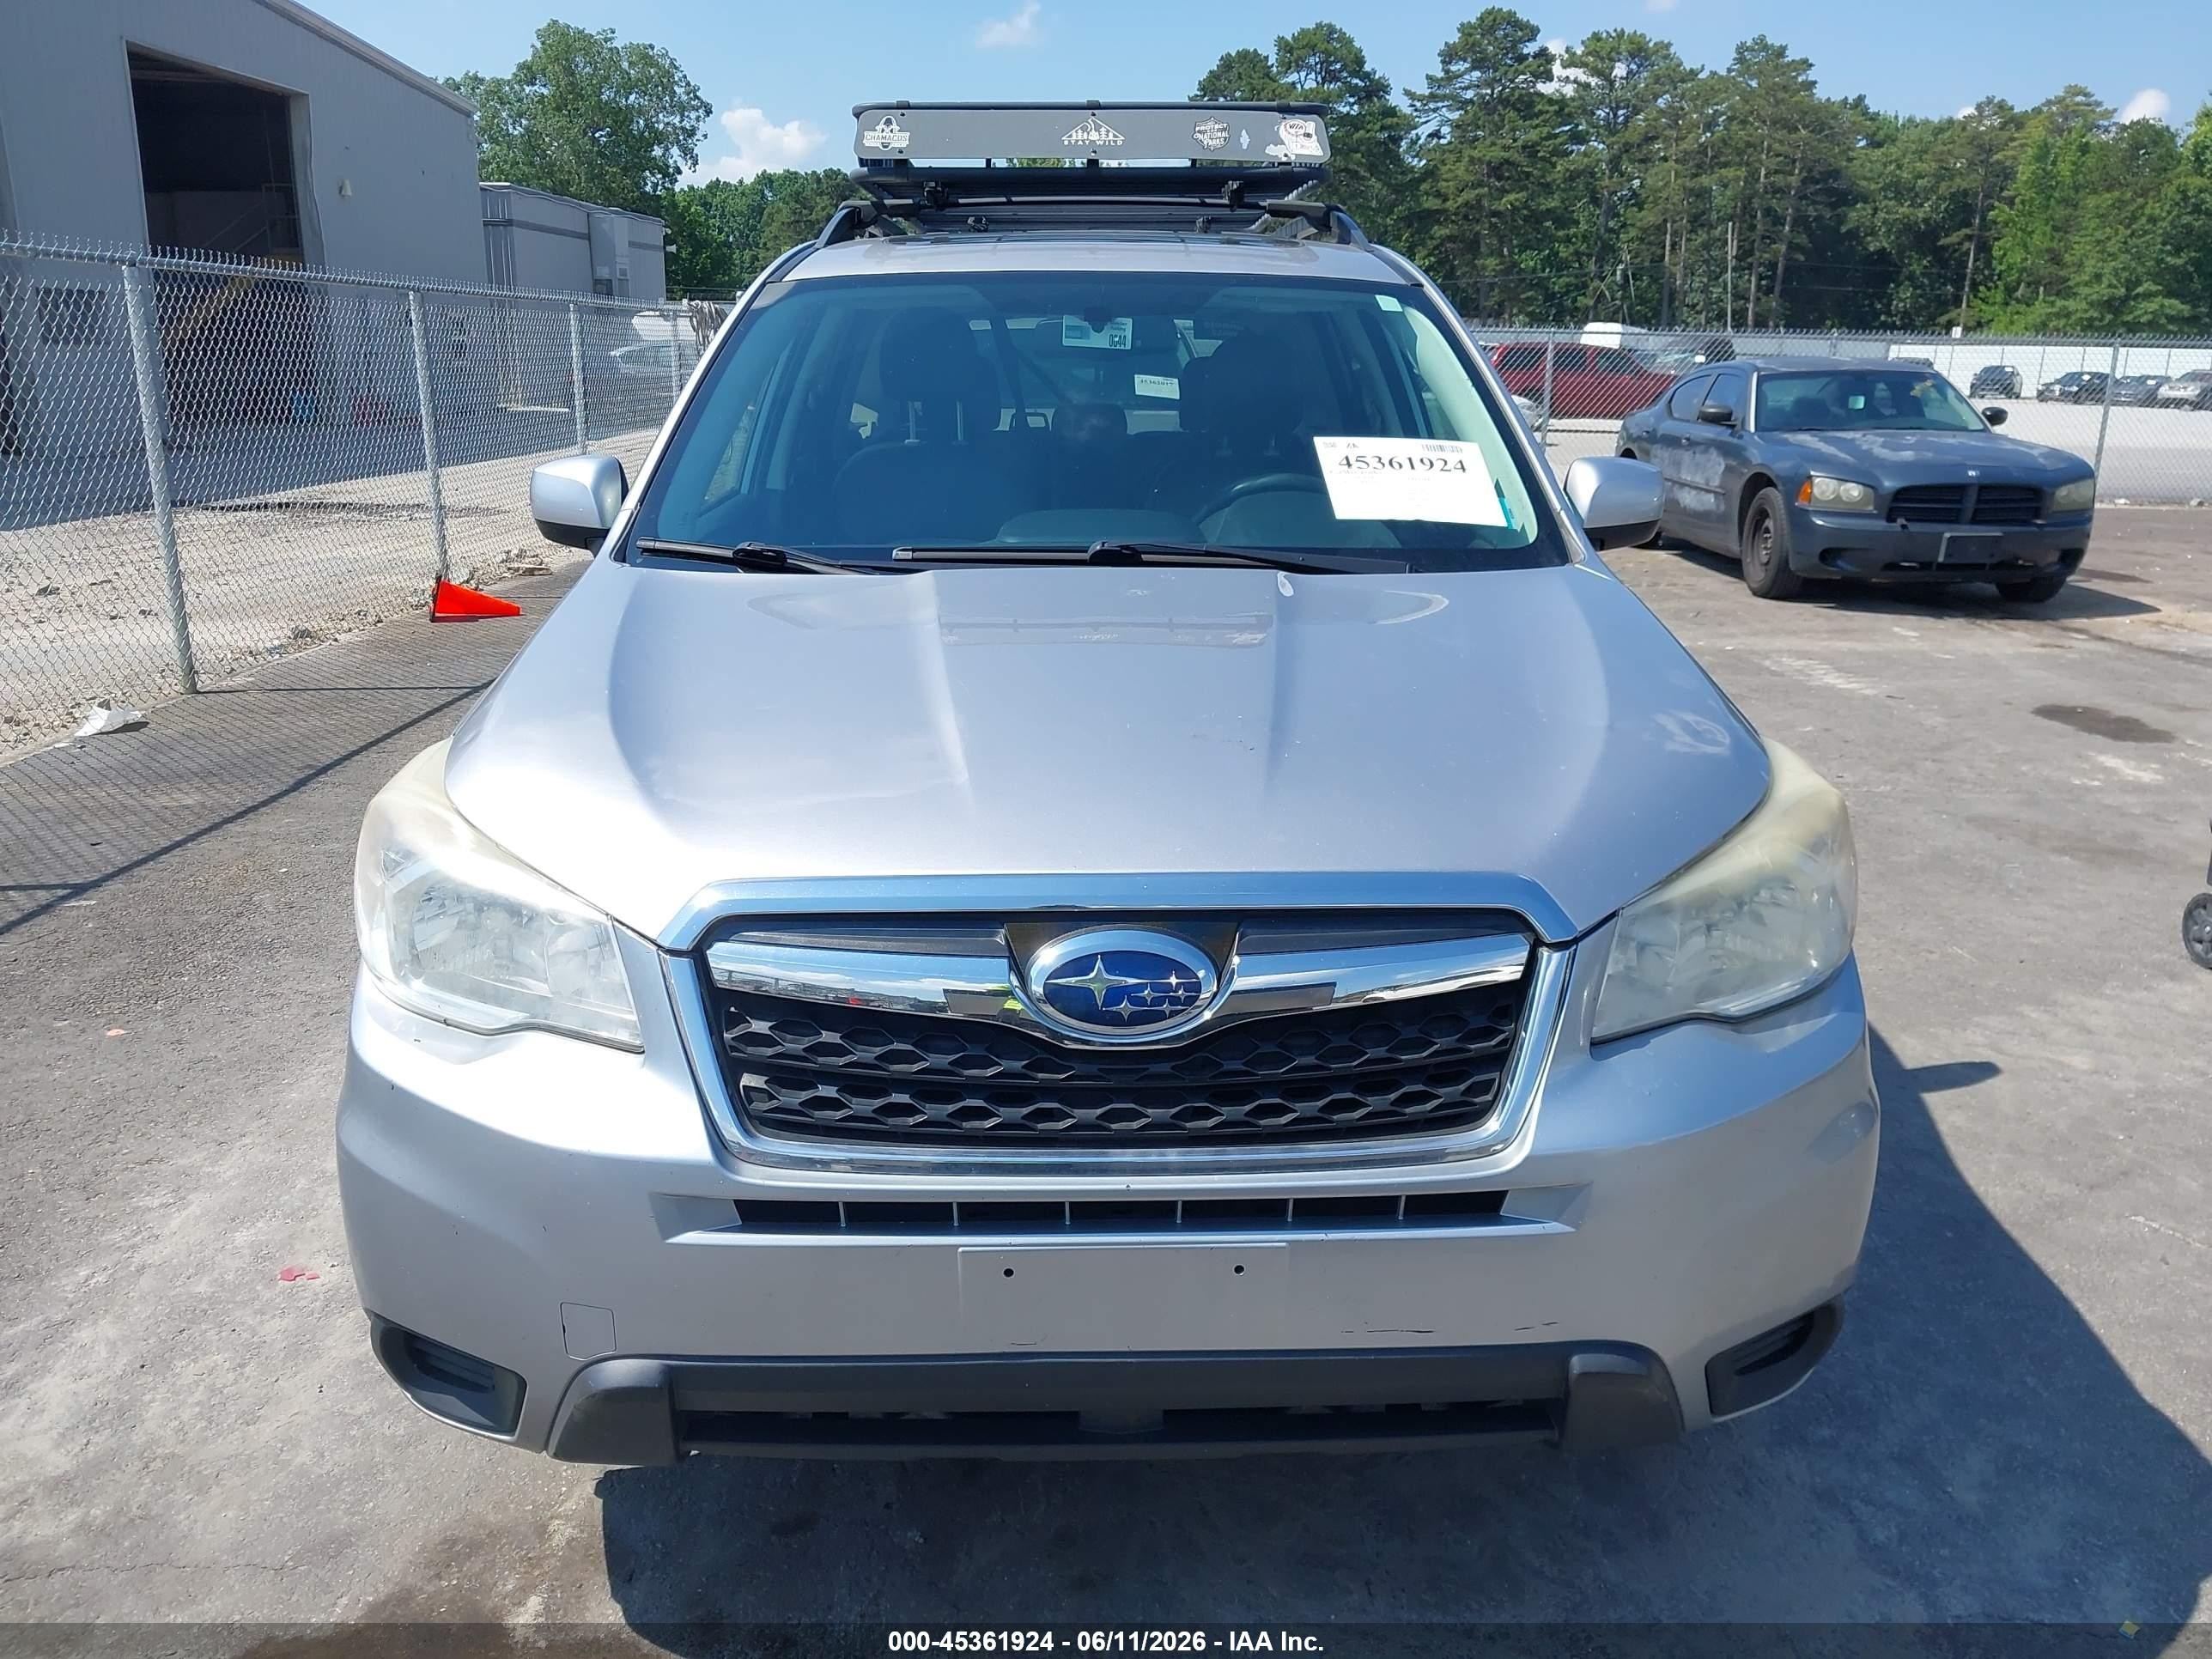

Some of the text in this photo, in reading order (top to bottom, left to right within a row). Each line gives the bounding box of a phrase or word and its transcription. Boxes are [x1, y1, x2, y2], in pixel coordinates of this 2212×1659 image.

[1195, 123, 1229, 131] PROTECT
[1193, 131, 1231, 142] NATIONAL
[1203, 137, 1225, 149] PARKS
[1339, 454, 1468, 473] 45361924
